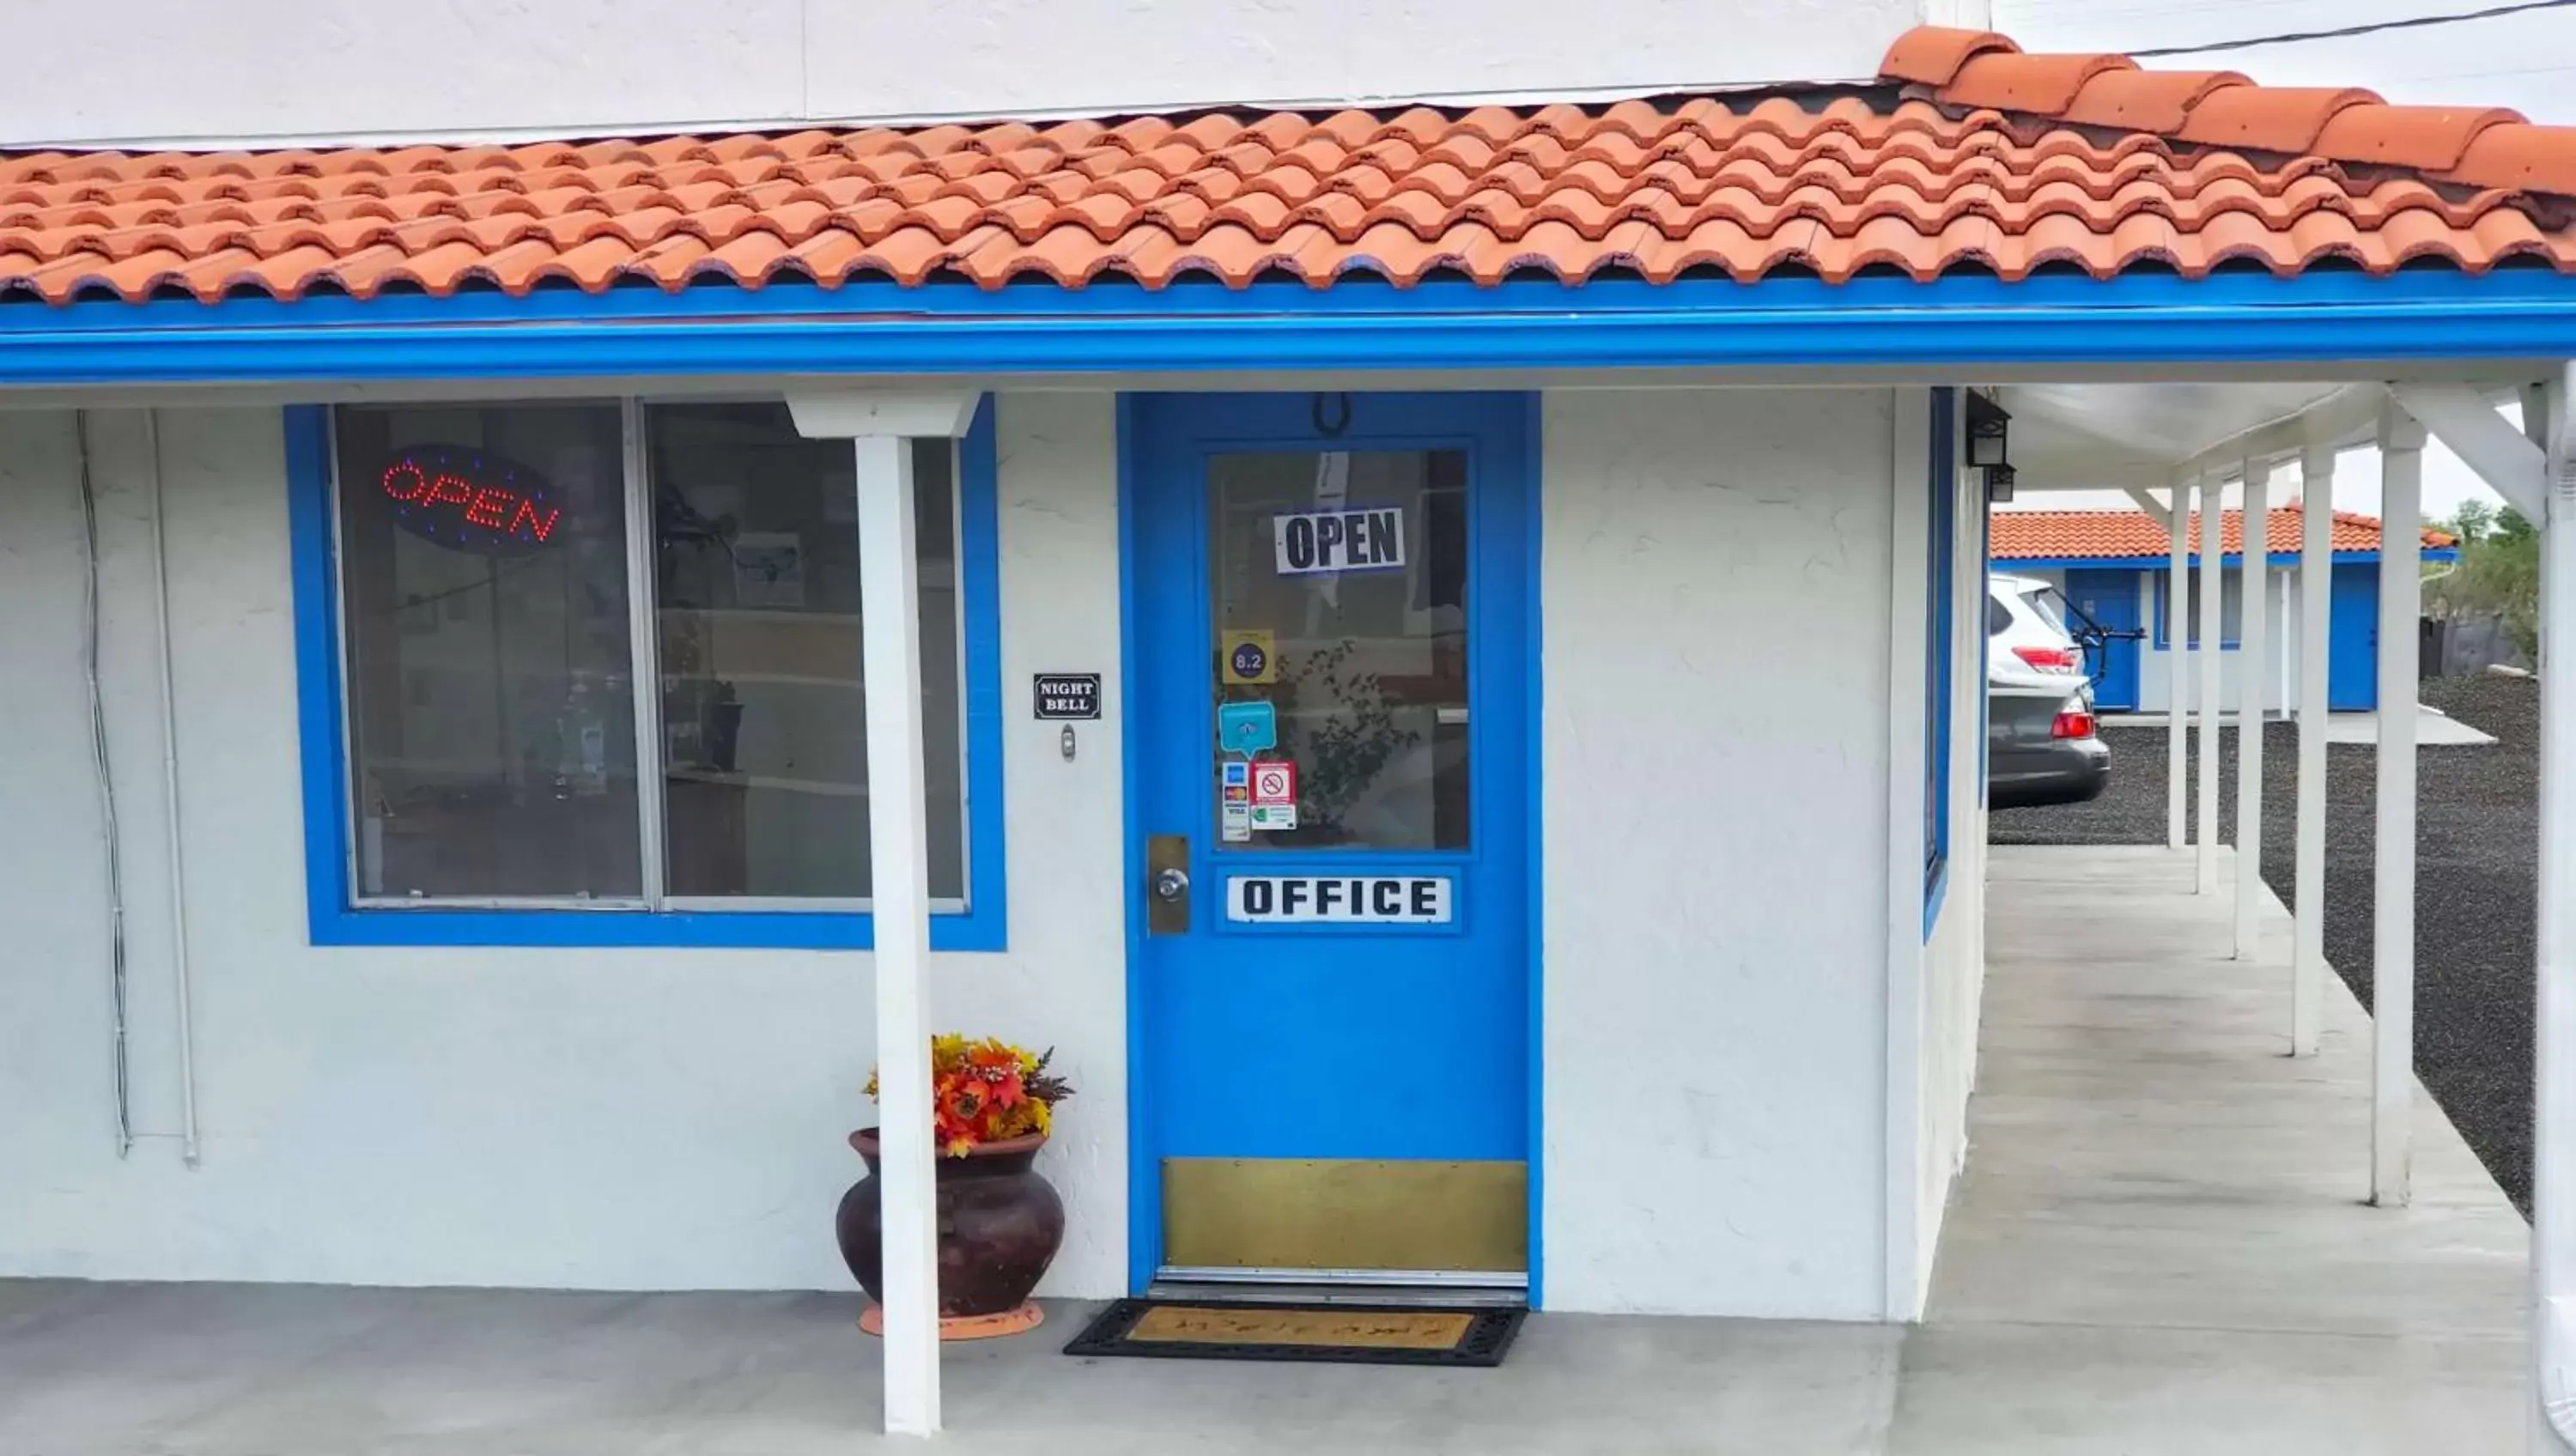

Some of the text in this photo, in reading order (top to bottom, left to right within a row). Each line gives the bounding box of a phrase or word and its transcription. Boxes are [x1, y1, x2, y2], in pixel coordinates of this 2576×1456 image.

[384, 464, 561, 543] OPEN
[1285, 512, 1398, 569] OPEN
[1235, 654, 1262, 670] 8.2
[1040, 682, 1094, 695] NIGHT
[1045, 698, 1090, 711] BELL
[1242, 880, 1437, 916] OFFICE
